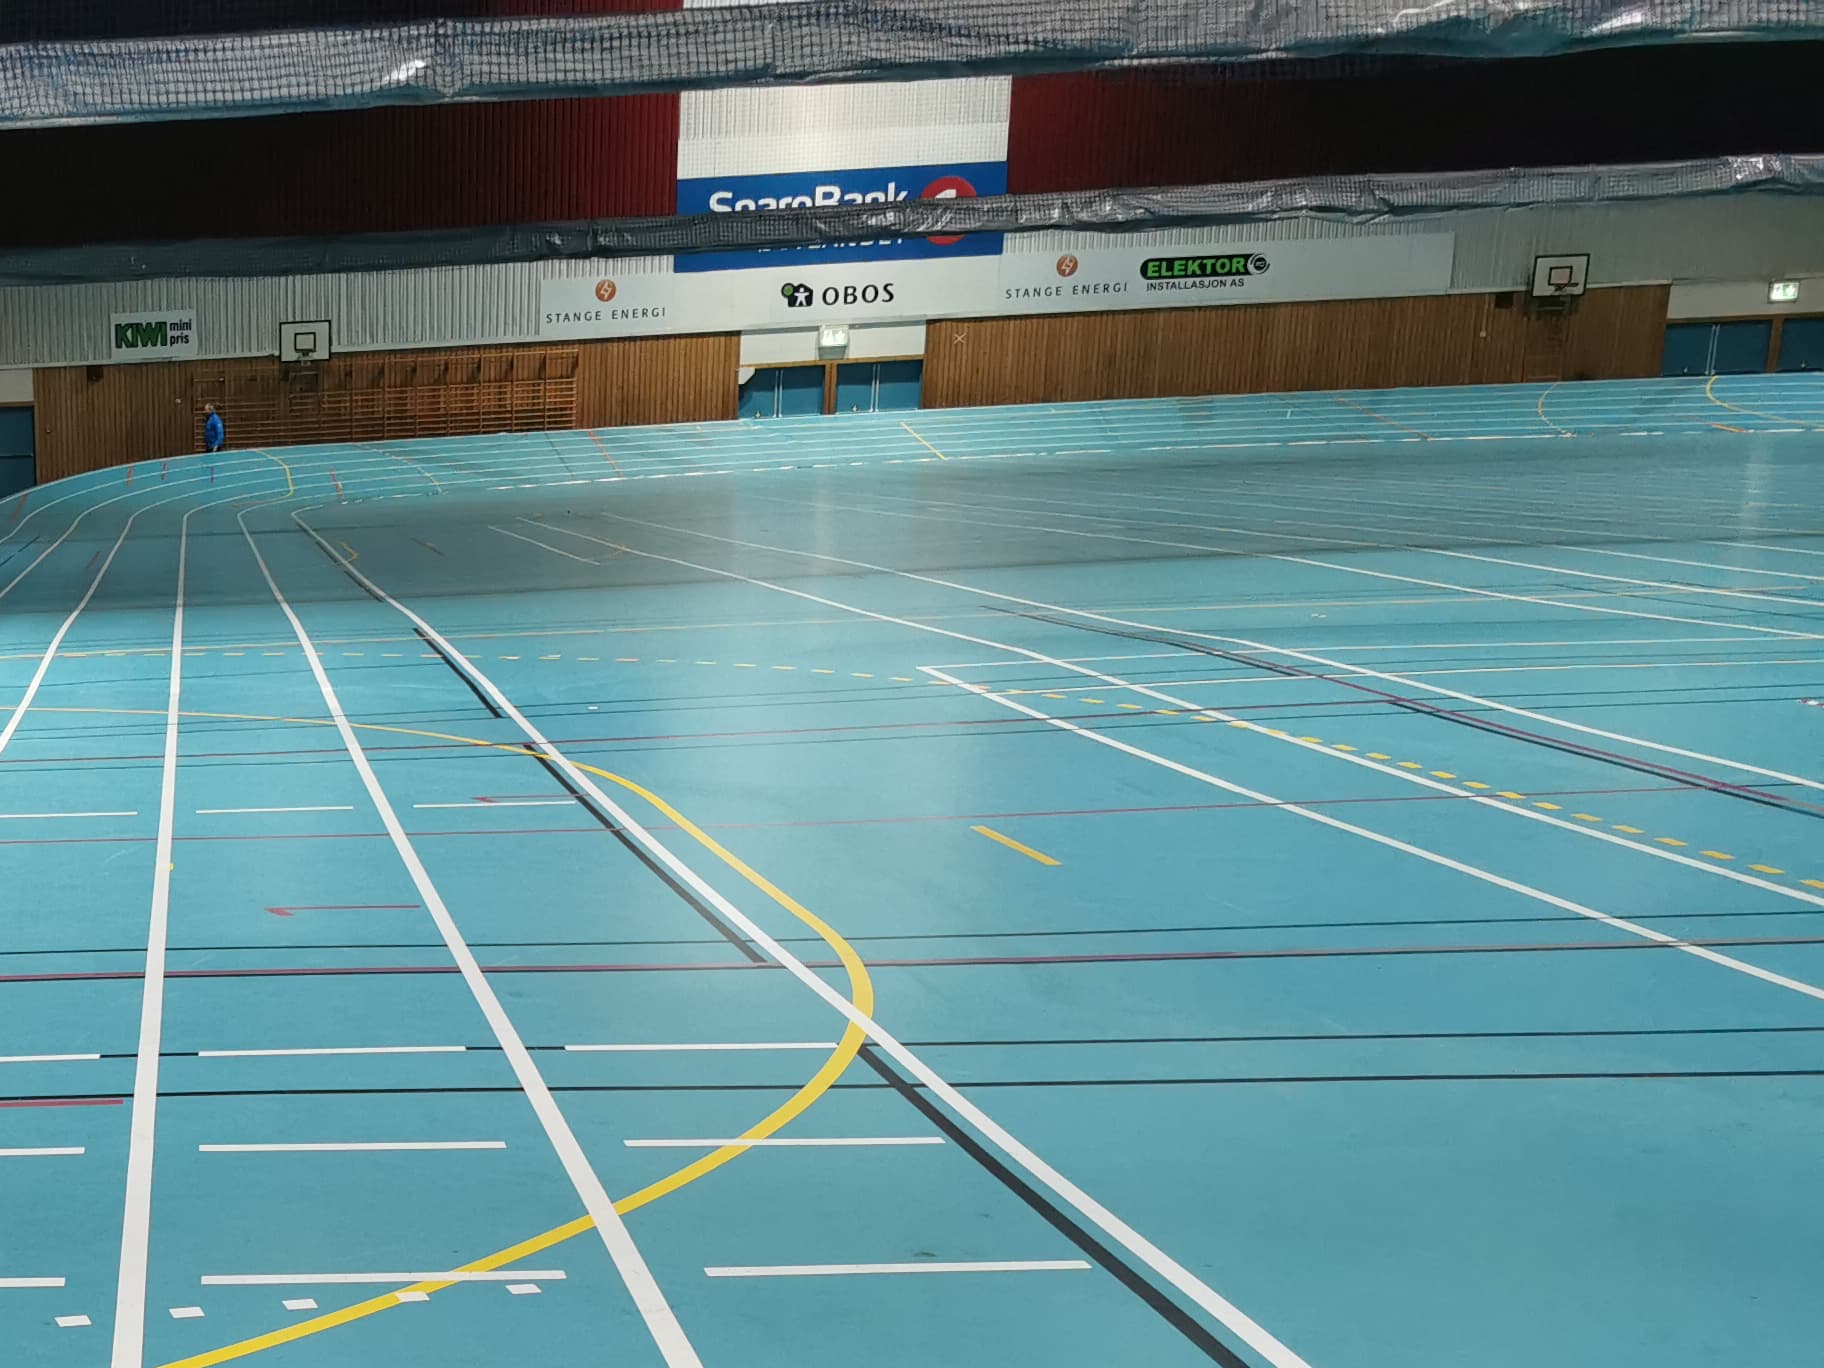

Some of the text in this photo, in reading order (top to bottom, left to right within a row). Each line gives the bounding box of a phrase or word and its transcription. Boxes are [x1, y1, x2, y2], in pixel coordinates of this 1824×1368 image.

[1147, 257, 1246, 278] ELEKTOR
[1005, 283, 1127, 300] STANGE ENERGI
[1146, 278, 1245, 292] INSTALLASJON AS
[822, 283, 895, 306] OBOS
[546, 307, 666, 324] STANGE ENERGI
[169, 319, 192, 331] mini
[114, 321, 168, 349] KIWI
[170, 332, 190, 346] pris
